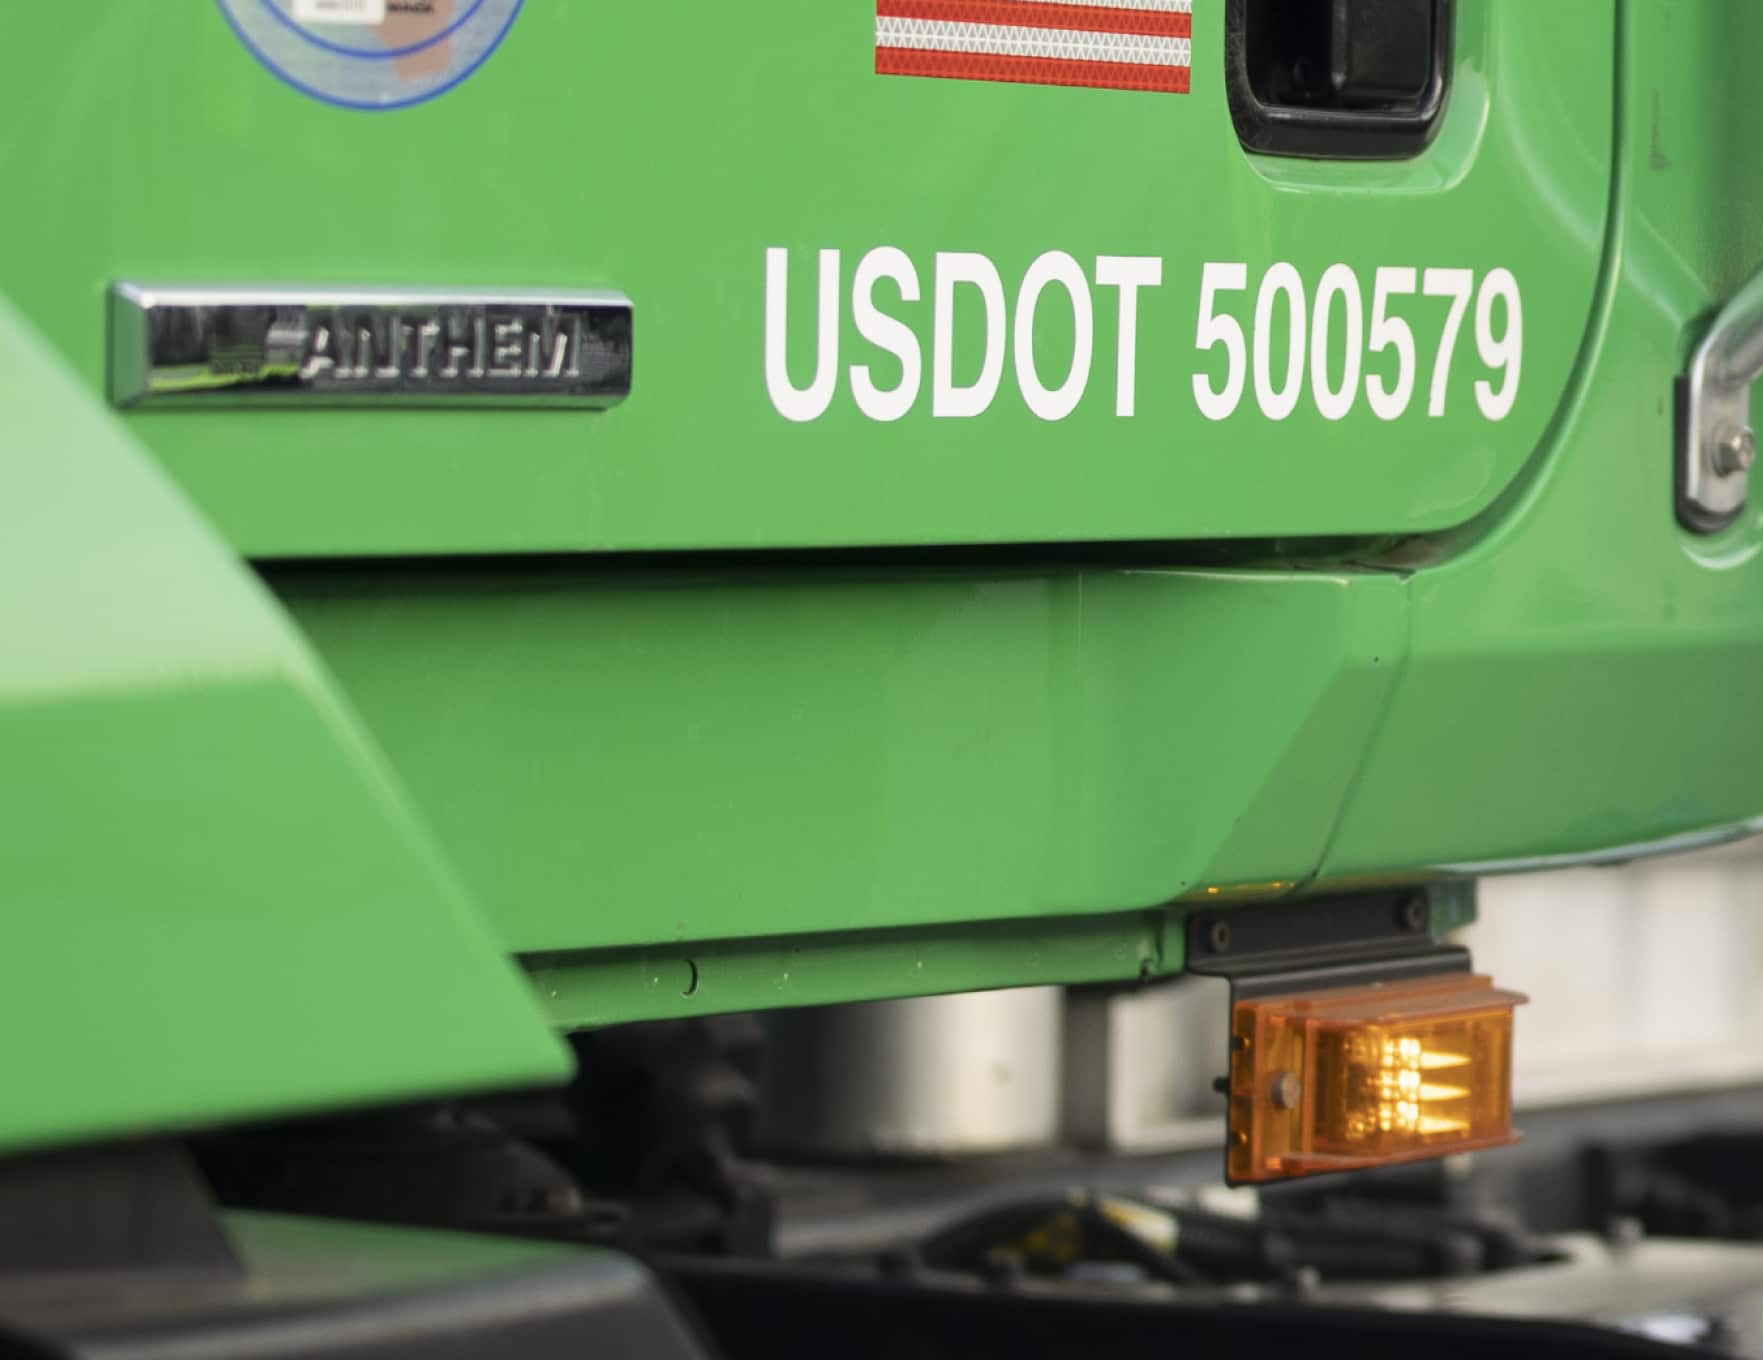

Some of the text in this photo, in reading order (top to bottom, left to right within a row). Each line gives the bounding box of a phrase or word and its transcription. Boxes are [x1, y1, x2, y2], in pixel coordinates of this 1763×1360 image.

[298, 314, 583, 380] ANTHEM
[764, 246, 1524, 422] USDOT 500579
